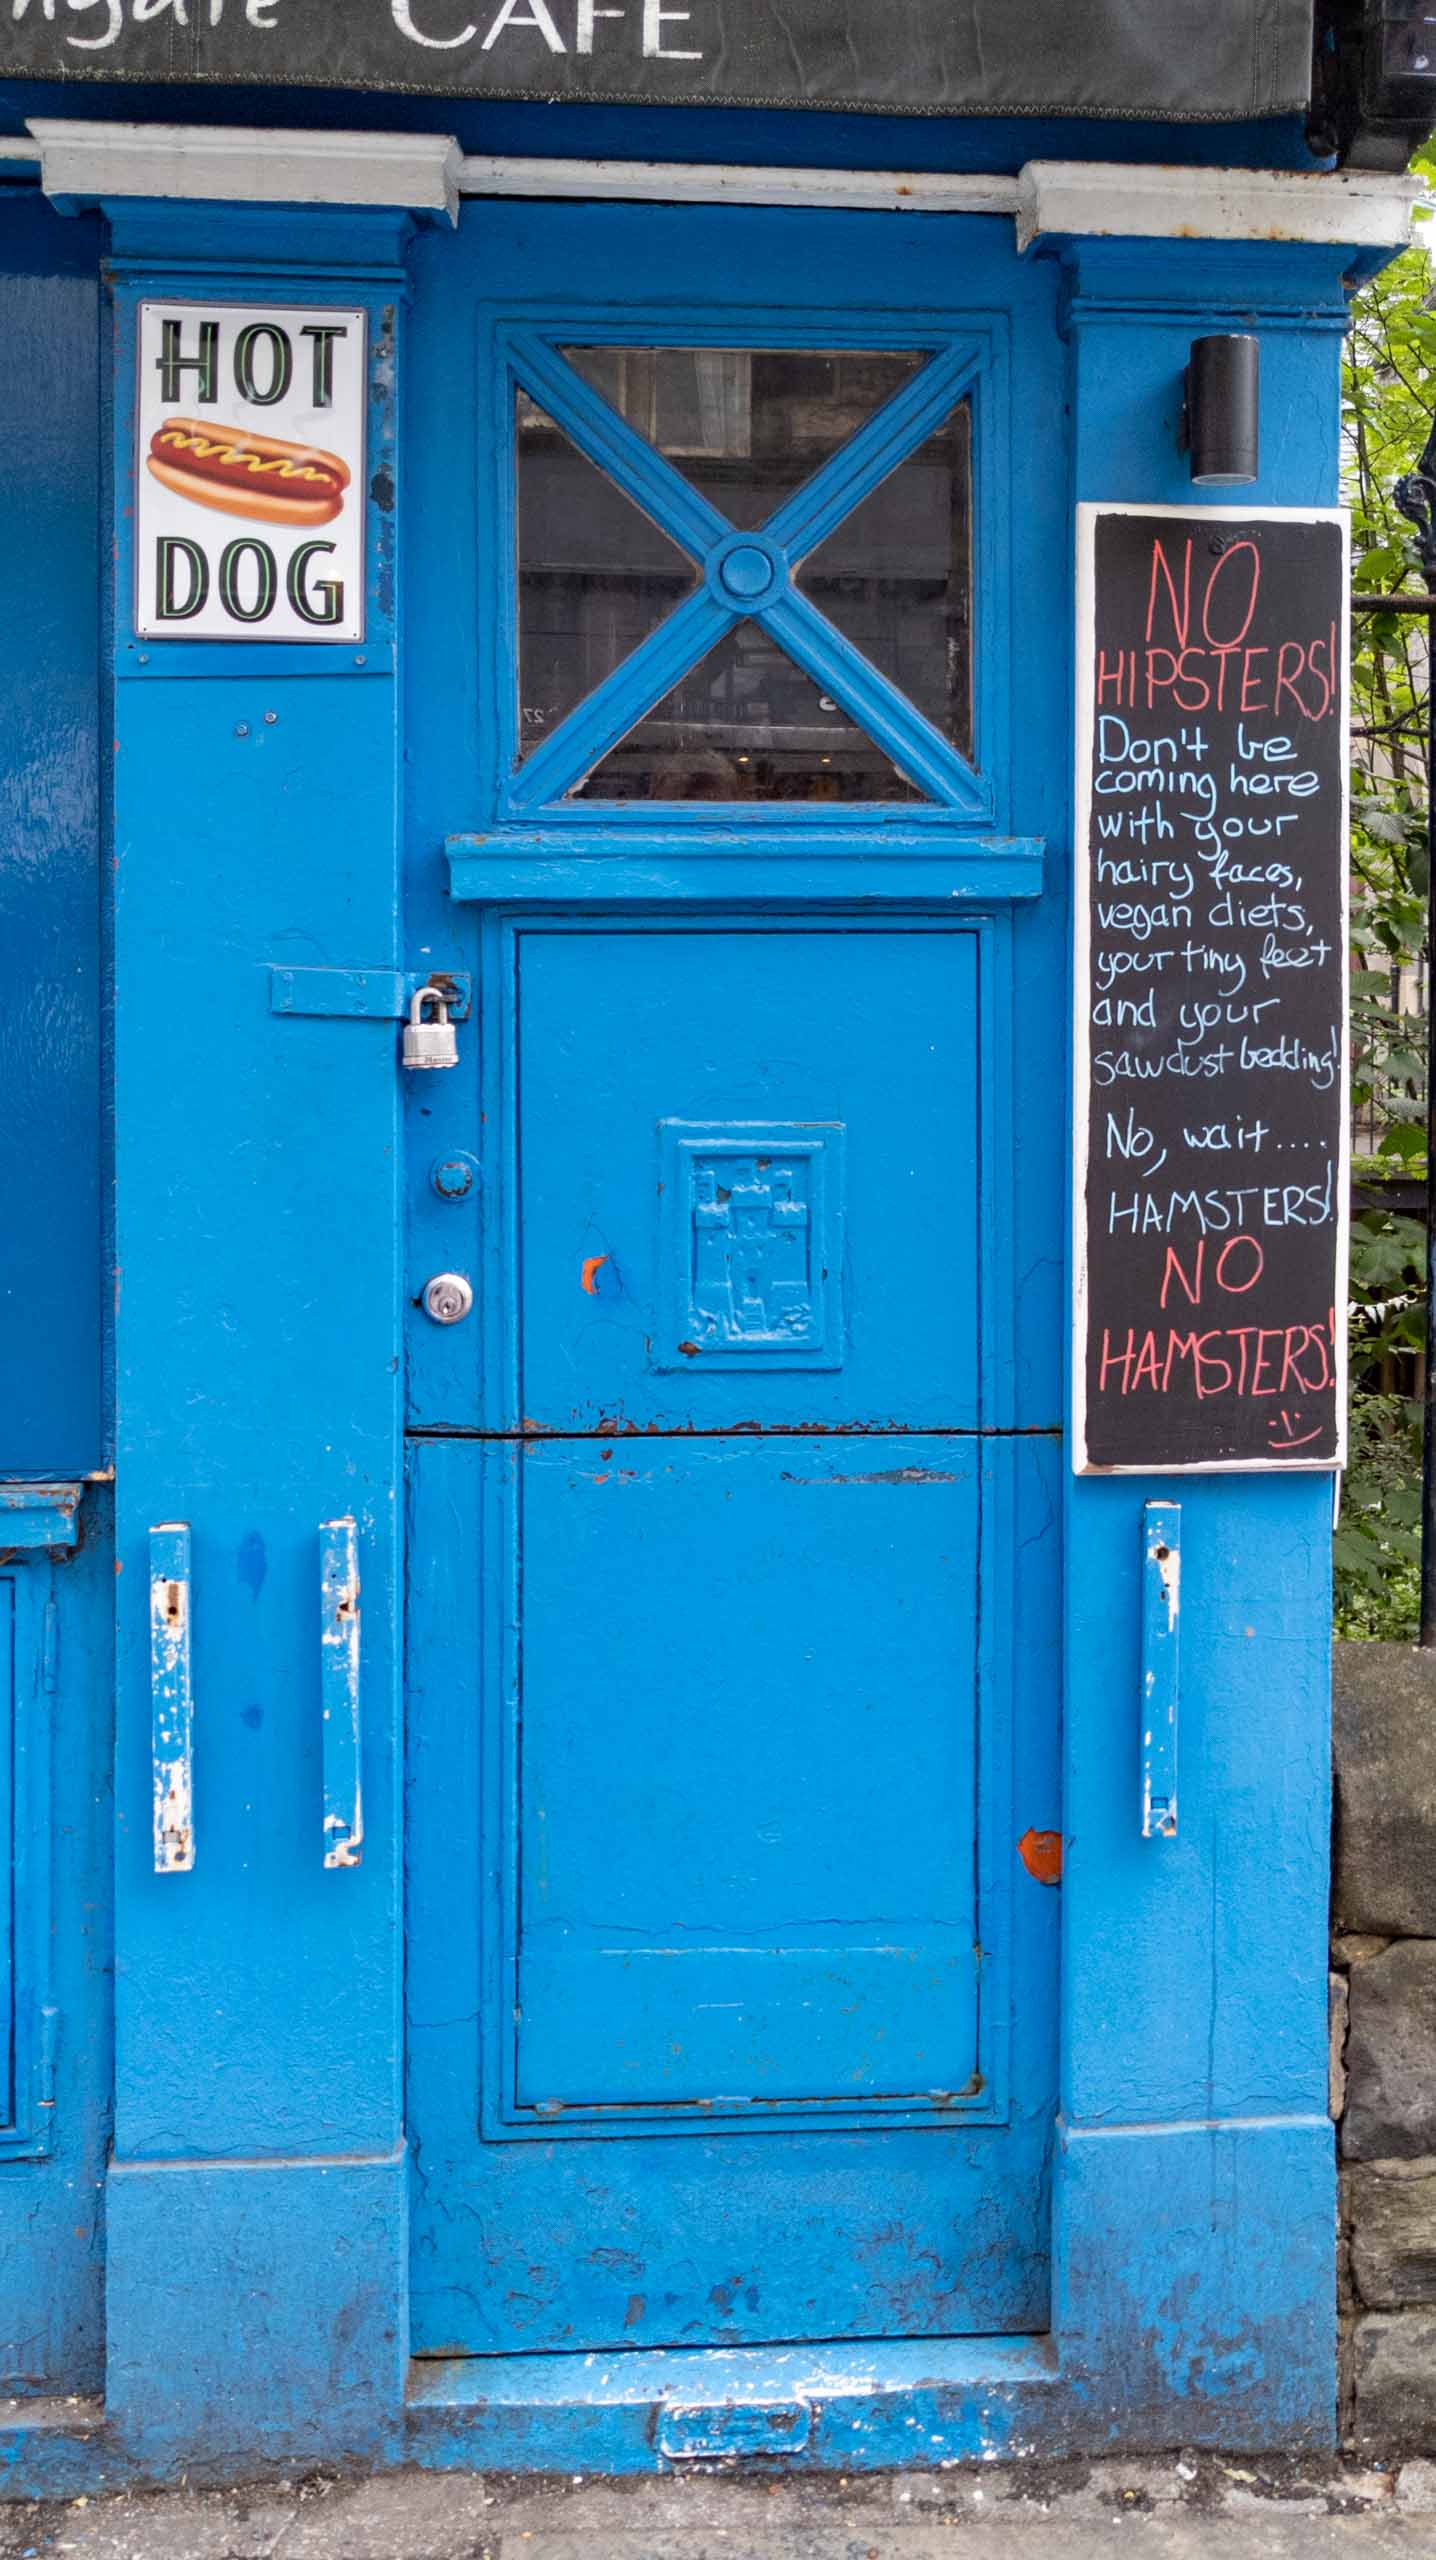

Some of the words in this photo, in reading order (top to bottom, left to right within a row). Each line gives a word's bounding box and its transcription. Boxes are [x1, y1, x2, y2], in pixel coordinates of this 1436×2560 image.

[156, 320, 347, 408] HOT
[156, 537, 344, 626] DOG
[1145, 539, 1260, 649] NO
[1098, 621, 1336, 721] HIPSTERS!
[1098, 715, 1208, 765] Don't
[1238, 722, 1298, 761] be
[1095, 768, 1217, 821] coming
[1229, 763, 1321, 797] here
[1098, 800, 1175, 845] with
[1194, 814, 1298, 861] your
[1097, 848, 1194, 899] hairy
[1209, 849, 1302, 891] faces,
[1098, 902, 1192, 940] vegan
[1208, 892, 1313, 936] diets,
[1096, 952, 1174, 990] your
[1180, 940, 1246, 996] tiny
[1260, 932, 1332, 979] feet
[1093, 987, 1156, 1027] and
[1177, 998, 1281, 1046] your
[1094, 1043, 1234, 1086] sawdust
[1240, 1025, 1341, 1089] bedding!
[1106, 1107, 1167, 1177] No,
[1108, 1160, 1334, 1235] HAMSTERS!
[1160, 1235, 1264, 1309] NO
[1099, 1306, 1336, 1399] HAMSTERS!
